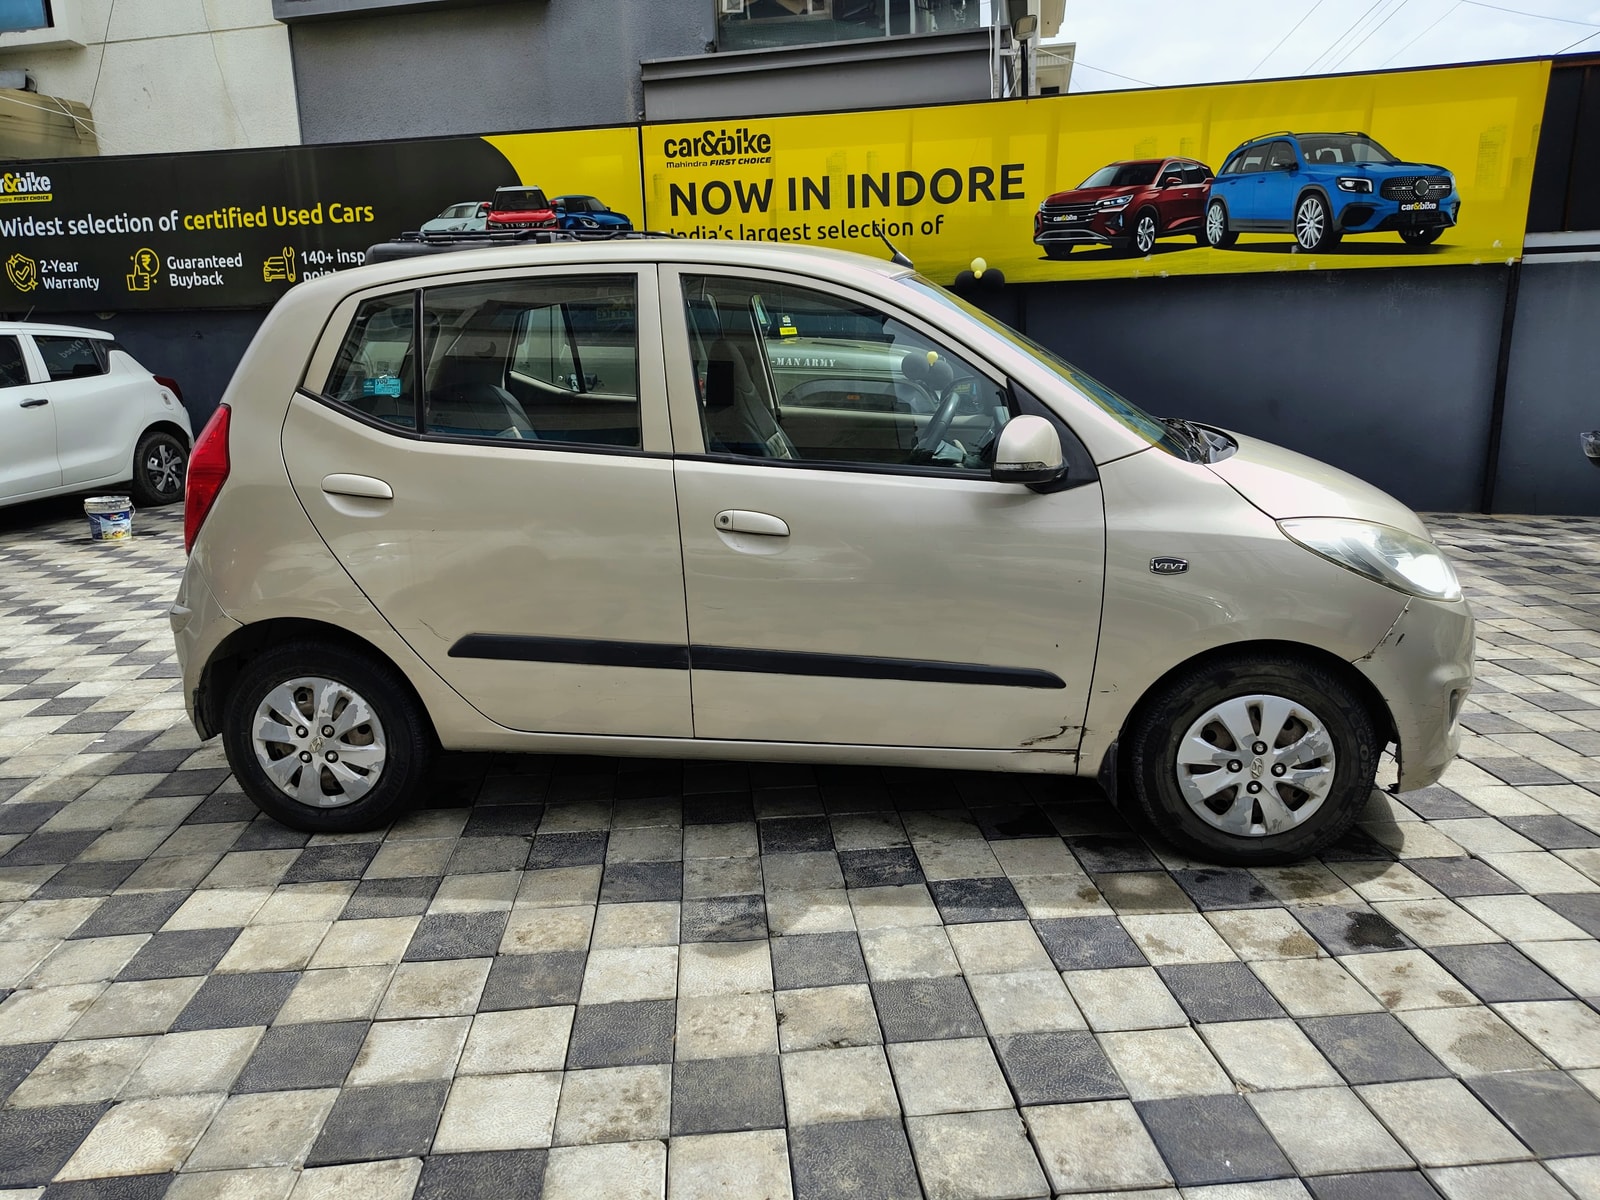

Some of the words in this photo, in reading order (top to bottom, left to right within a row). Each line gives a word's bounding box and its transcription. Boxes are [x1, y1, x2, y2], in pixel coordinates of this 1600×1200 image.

[664, 128, 771, 158] car&bike
[738, 157, 772, 165] CHOICE
[670, 179, 773, 216] NOW
[788, 176, 831, 212] IN
[847, 163, 1025, 209] INDORE
[1401, 201, 1437, 211] car&bike
[0, 216, 64, 237] Widest
[69, 213, 153, 235] selection
[158, 210, 178, 231] of
[184, 205, 267, 231] certified
[273, 203, 323, 226] Used
[329, 203, 374, 223] Cars
[740, 223, 811, 242] largest
[817, 217, 914, 239] selection
[921, 214, 944, 235] of
[167, 253, 243, 269] Guaranteed
[301, 250, 334, 265] 140+
[40, 259, 78, 273] 2-Year
[42, 275, 100, 291] Warranty
[169, 271, 224, 289] Buyback
[804, 358, 836, 367] ARMY
[1155, 562, 1186, 570] VTVT
